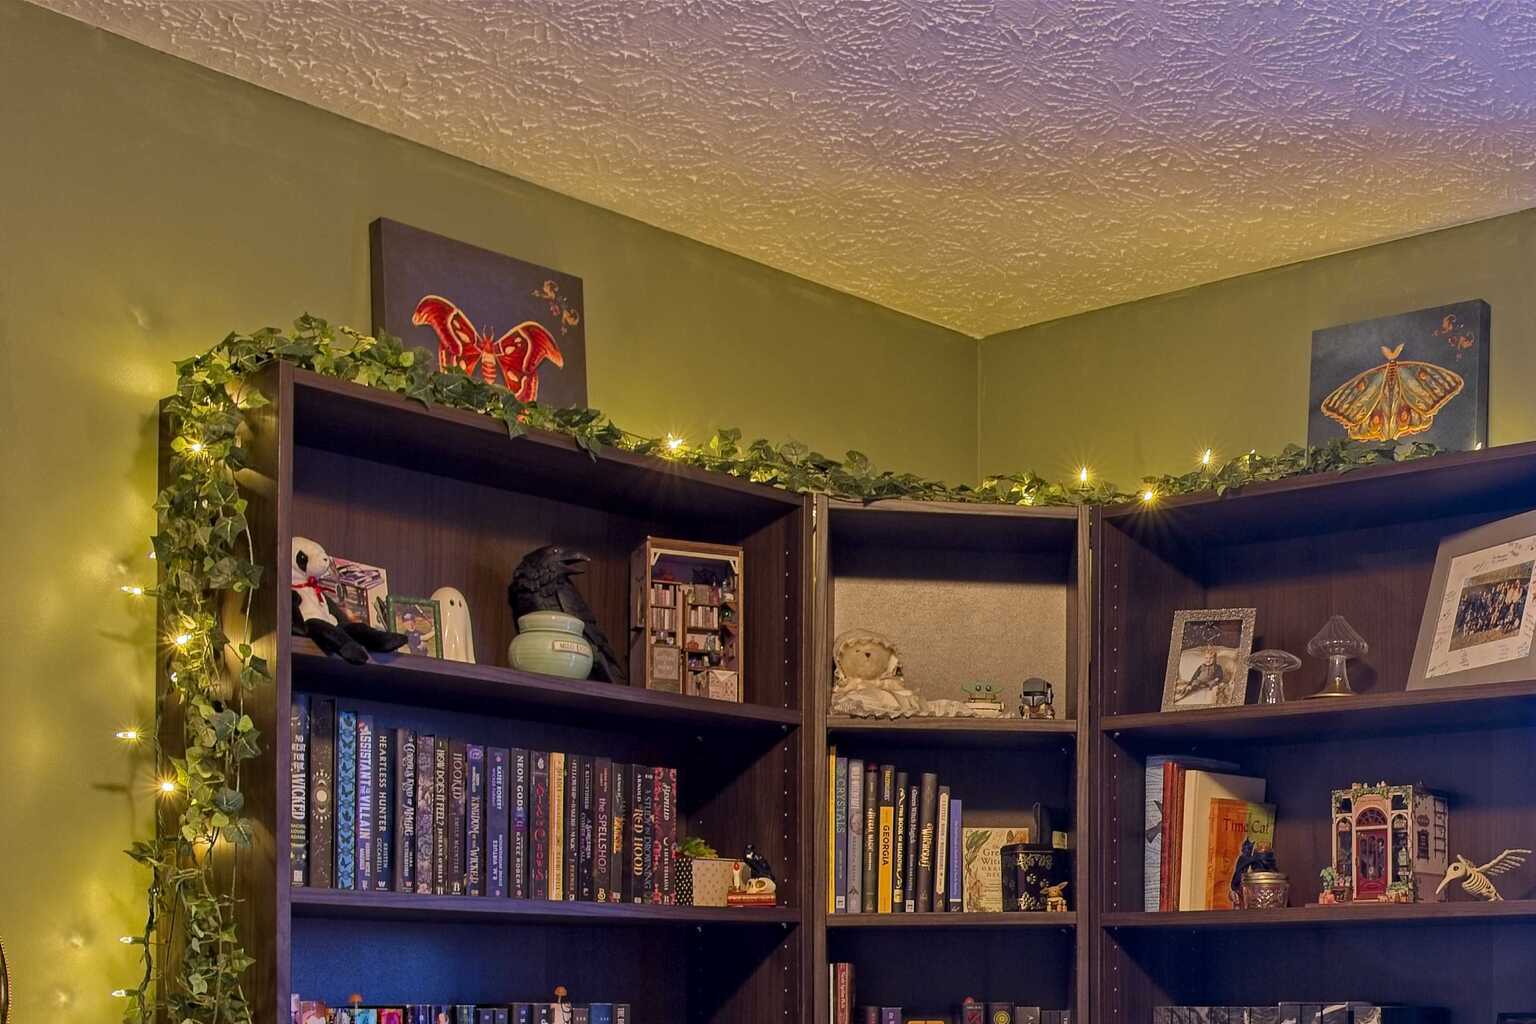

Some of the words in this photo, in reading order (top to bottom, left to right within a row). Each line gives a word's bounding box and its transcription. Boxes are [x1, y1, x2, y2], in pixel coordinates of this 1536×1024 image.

[359, 730, 371, 787] ASSISTANT
[378, 735, 388, 787] HEARTLESS
[516, 755, 524, 782] NEON
[291, 773, 306, 820] WICKED
[436, 770, 445, 793] DOES
[516, 785, 524, 811] GODS
[359, 796, 371, 839] VILLAIN
[378, 792, 388, 832] HUNTER
[436, 802, 445, 826] FEEL?
[468, 796, 481, 834] KINGDOM
[598, 797, 606, 811] the
[598, 814, 607, 873] SPELLSHOP
[1224, 815, 1248, 832] Time
[1251, 820, 1271, 834] Cat
[633, 837, 644, 876] HOOD
[643, 836, 652, 888] DROWNING
[882, 824, 890, 866] GEORGIA
